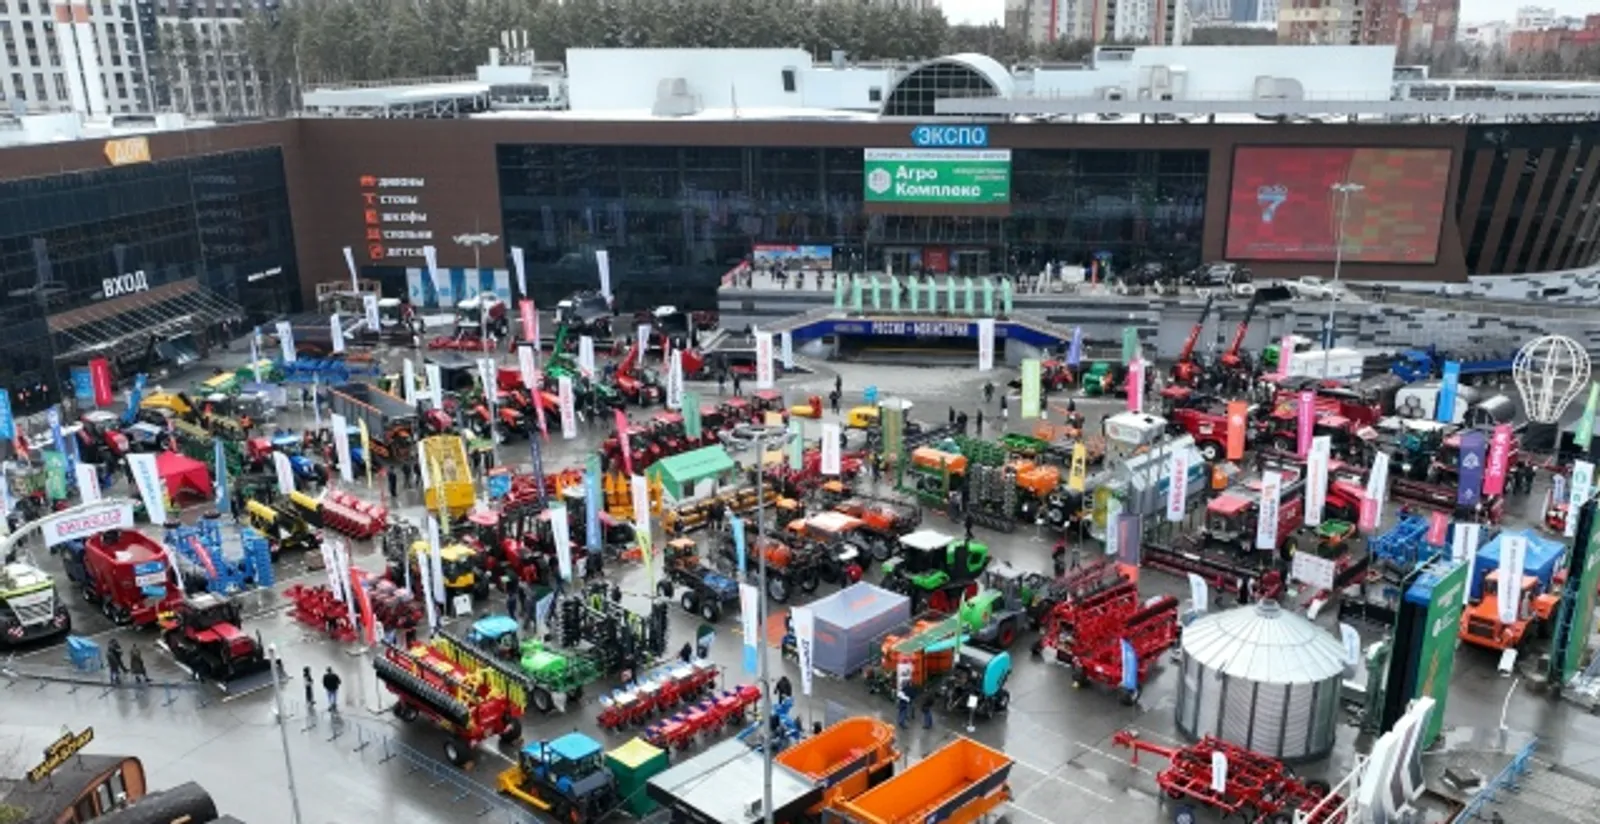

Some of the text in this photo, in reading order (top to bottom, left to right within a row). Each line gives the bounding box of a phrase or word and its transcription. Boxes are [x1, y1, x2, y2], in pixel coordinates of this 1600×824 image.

[918, 127, 986, 145] ЭКСПО
[896, 165, 938, 181] Агро
[895, 183, 981, 197] Комплекс
[102, 269, 149, 298] ВХОД
[871, 321, 906, 335] РОССИЯ
